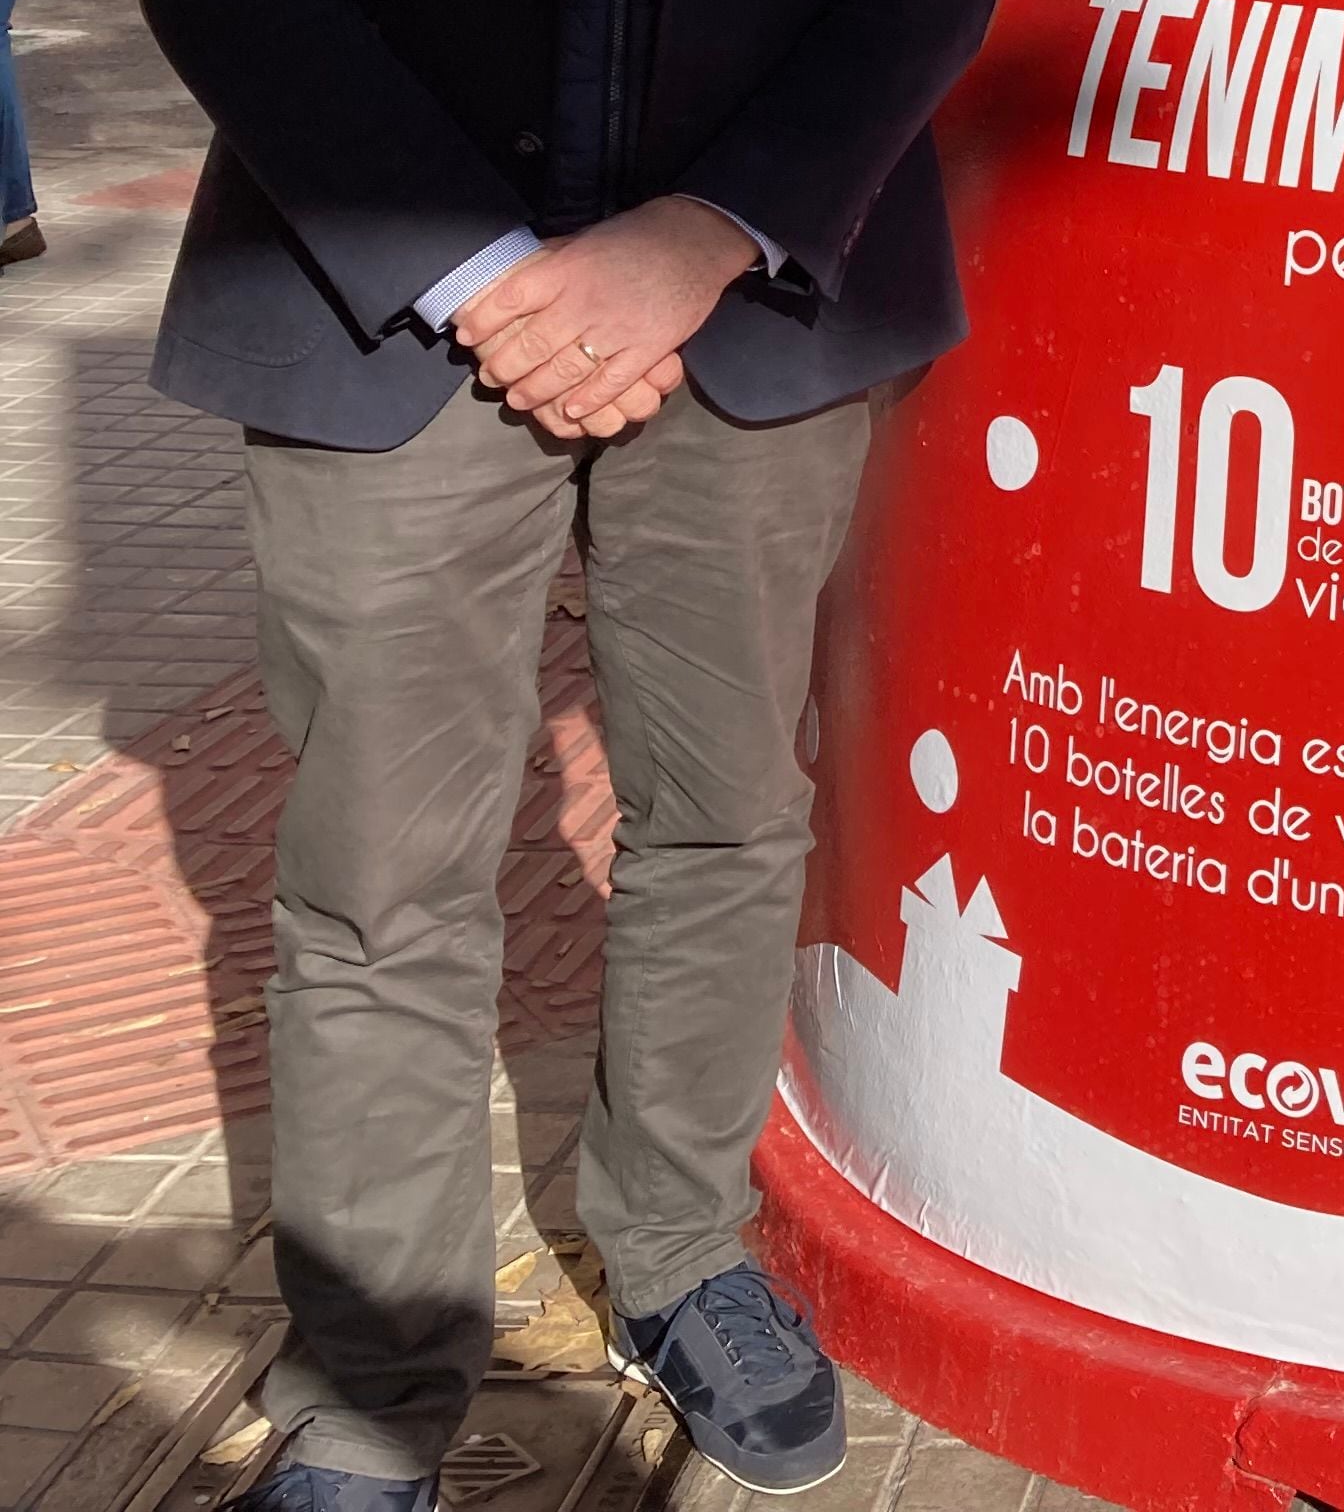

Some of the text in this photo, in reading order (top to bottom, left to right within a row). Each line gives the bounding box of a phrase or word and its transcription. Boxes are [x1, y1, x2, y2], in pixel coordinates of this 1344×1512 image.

[1129, 364, 1295, 613] 10
[1297, 527, 1344, 565] de
[1002, 648, 1083, 716] Amb
[1100, 675, 1281, 766] l'energia
[1007, 717, 1049, 775] 10
[1066, 736, 1226, 825] botelles
[1248, 788, 1312, 842] de
[1023, 790, 1057, 847] la
[1073, 806, 1228, 895] bateria
[1177, 1104, 1274, 1144] ENTITAT
